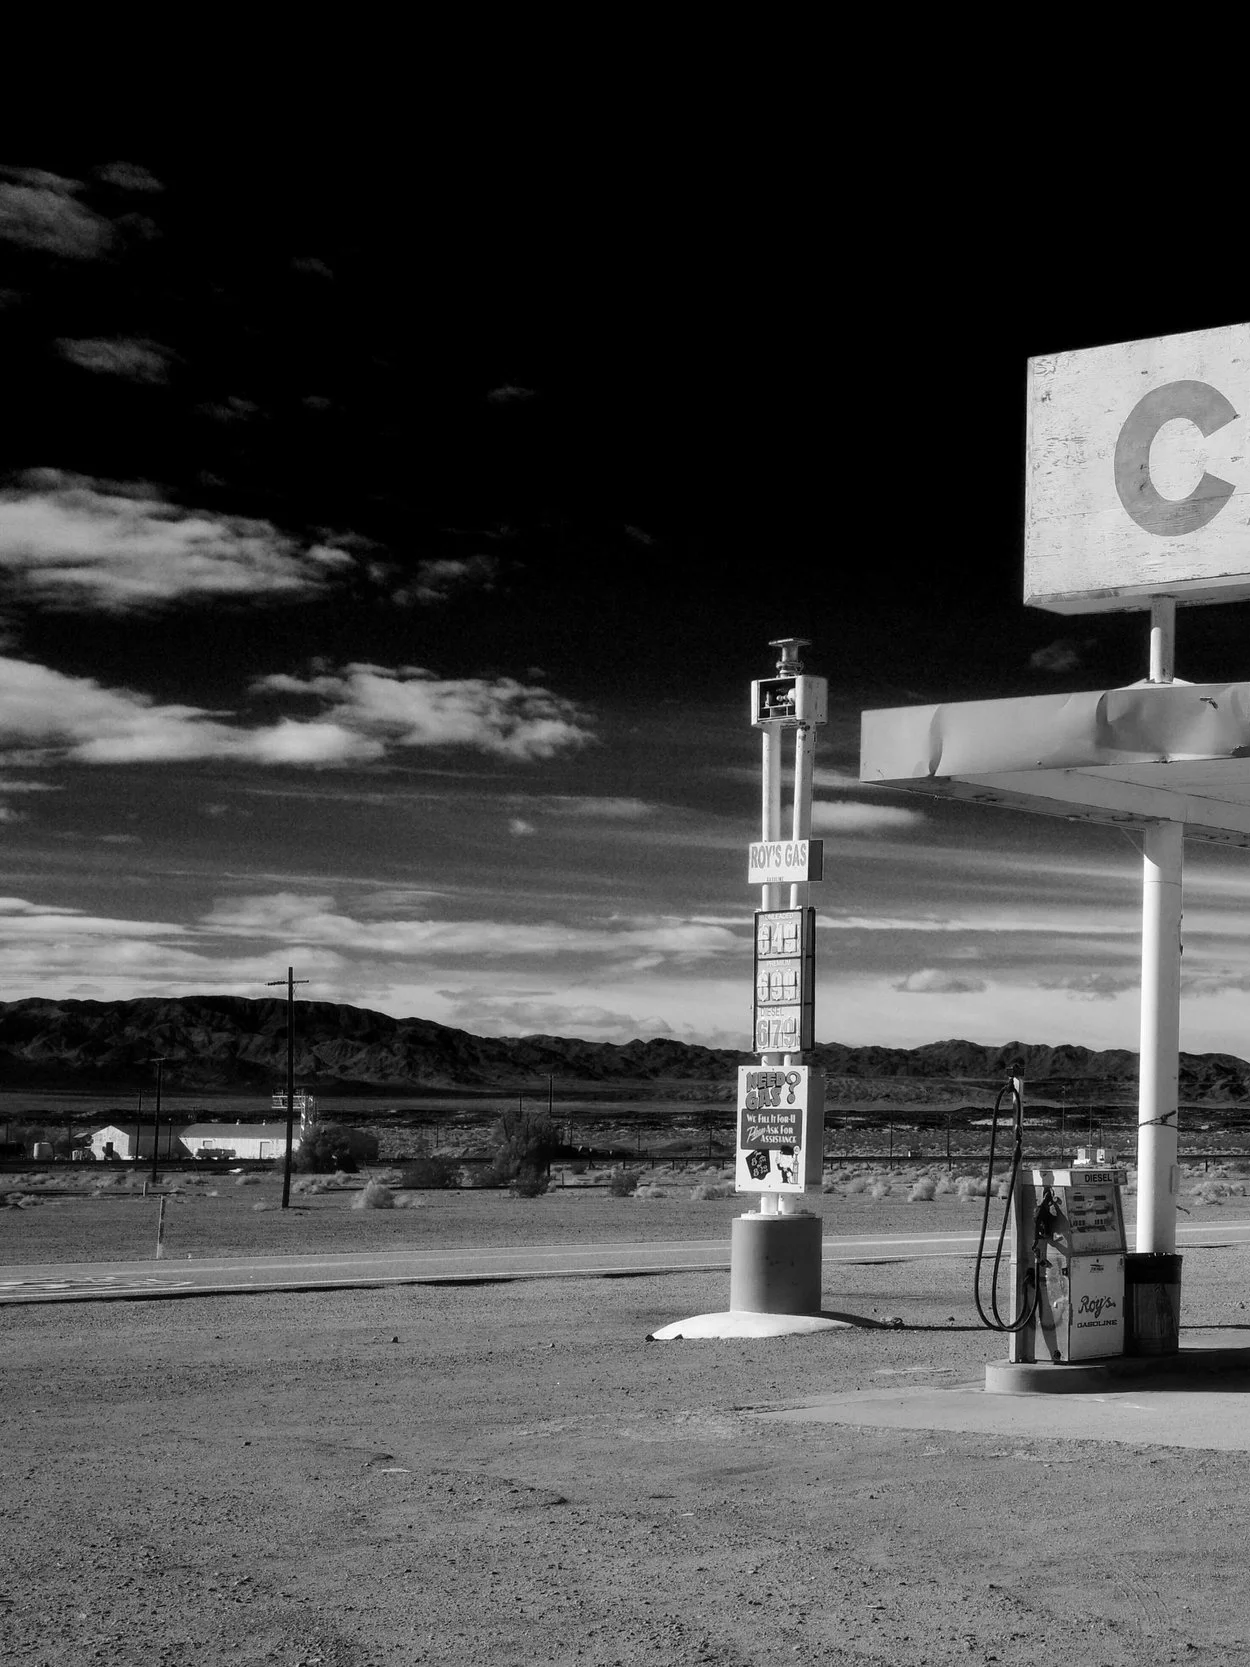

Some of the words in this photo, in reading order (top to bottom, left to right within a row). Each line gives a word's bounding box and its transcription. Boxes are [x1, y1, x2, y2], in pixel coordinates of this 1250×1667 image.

[751, 844, 782, 869] ROY'S
[785, 843, 807, 867] GAS
[746, 1071, 786, 1093] NEED
[745, 1087, 782, 1111] GAS
[1084, 1173, 1113, 1183] DIESEL
[1077, 1294, 1117, 1319] Roy's
[1077, 1319, 1119, 1329] GASOLINE
